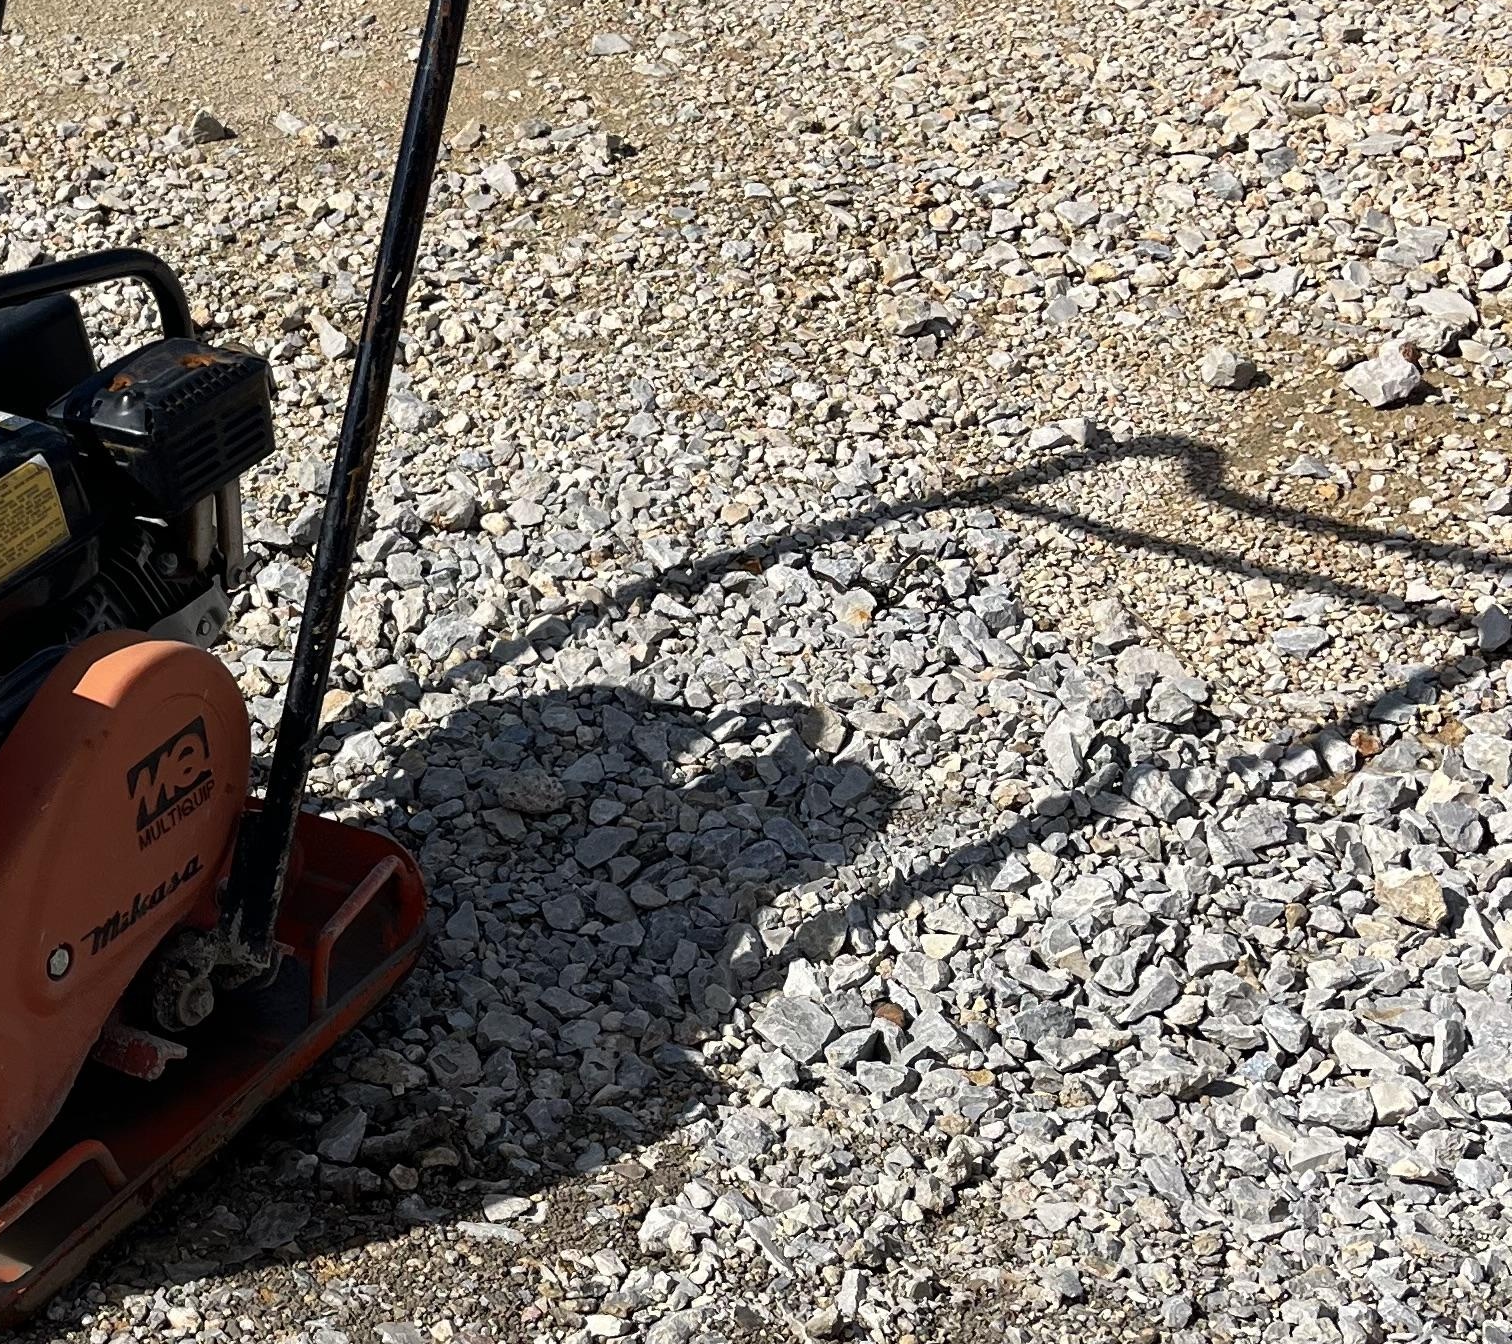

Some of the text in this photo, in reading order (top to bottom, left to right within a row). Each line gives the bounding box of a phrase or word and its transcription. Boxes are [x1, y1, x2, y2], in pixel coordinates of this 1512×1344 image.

[128, 724, 211, 829] MQ
[138, 779, 216, 851] MULTIQUIP
[81, 855, 204, 956] Mikasa
